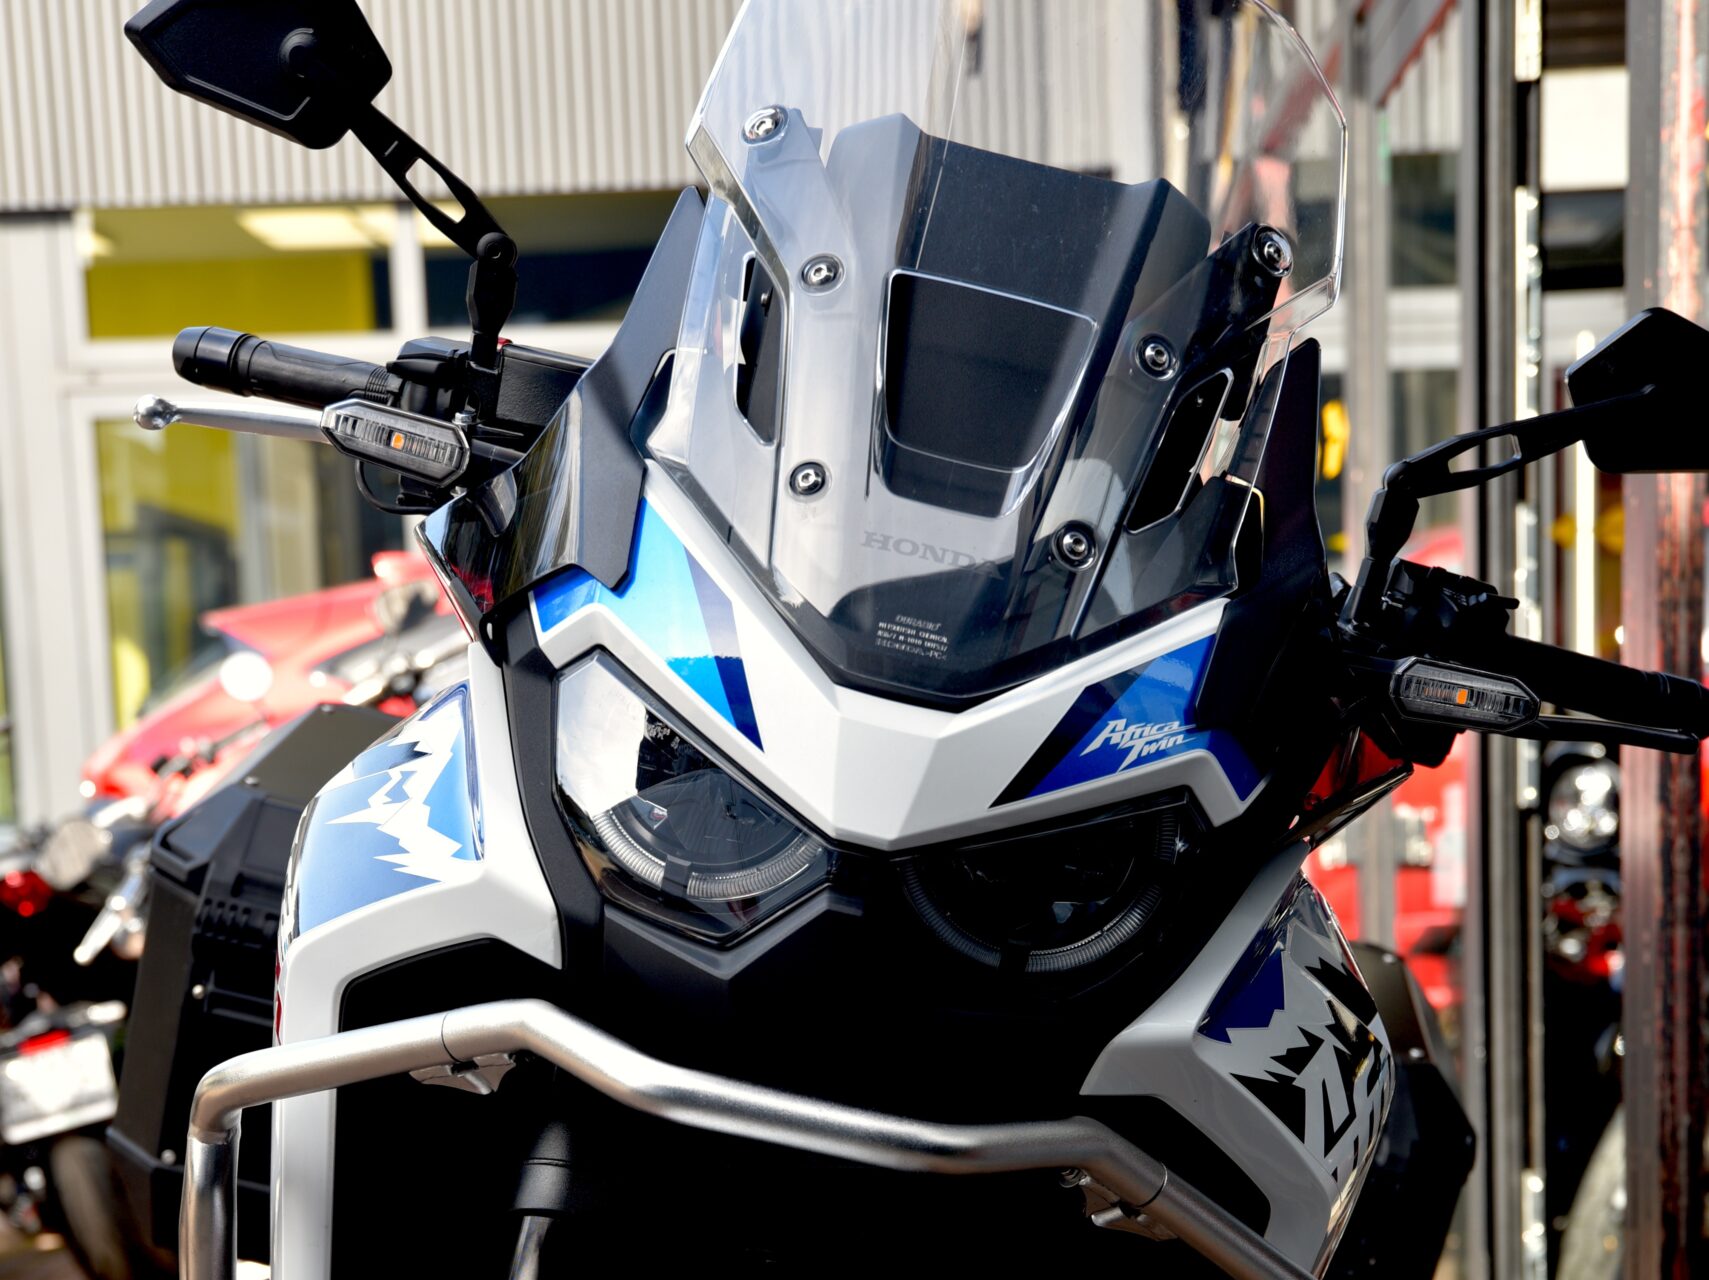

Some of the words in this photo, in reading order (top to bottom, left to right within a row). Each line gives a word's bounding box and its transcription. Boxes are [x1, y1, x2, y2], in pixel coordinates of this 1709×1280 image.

[861, 531, 1004, 580] HONDA
[1080, 718, 1196, 757] Africa
[1117, 728, 1196, 773] Twin
